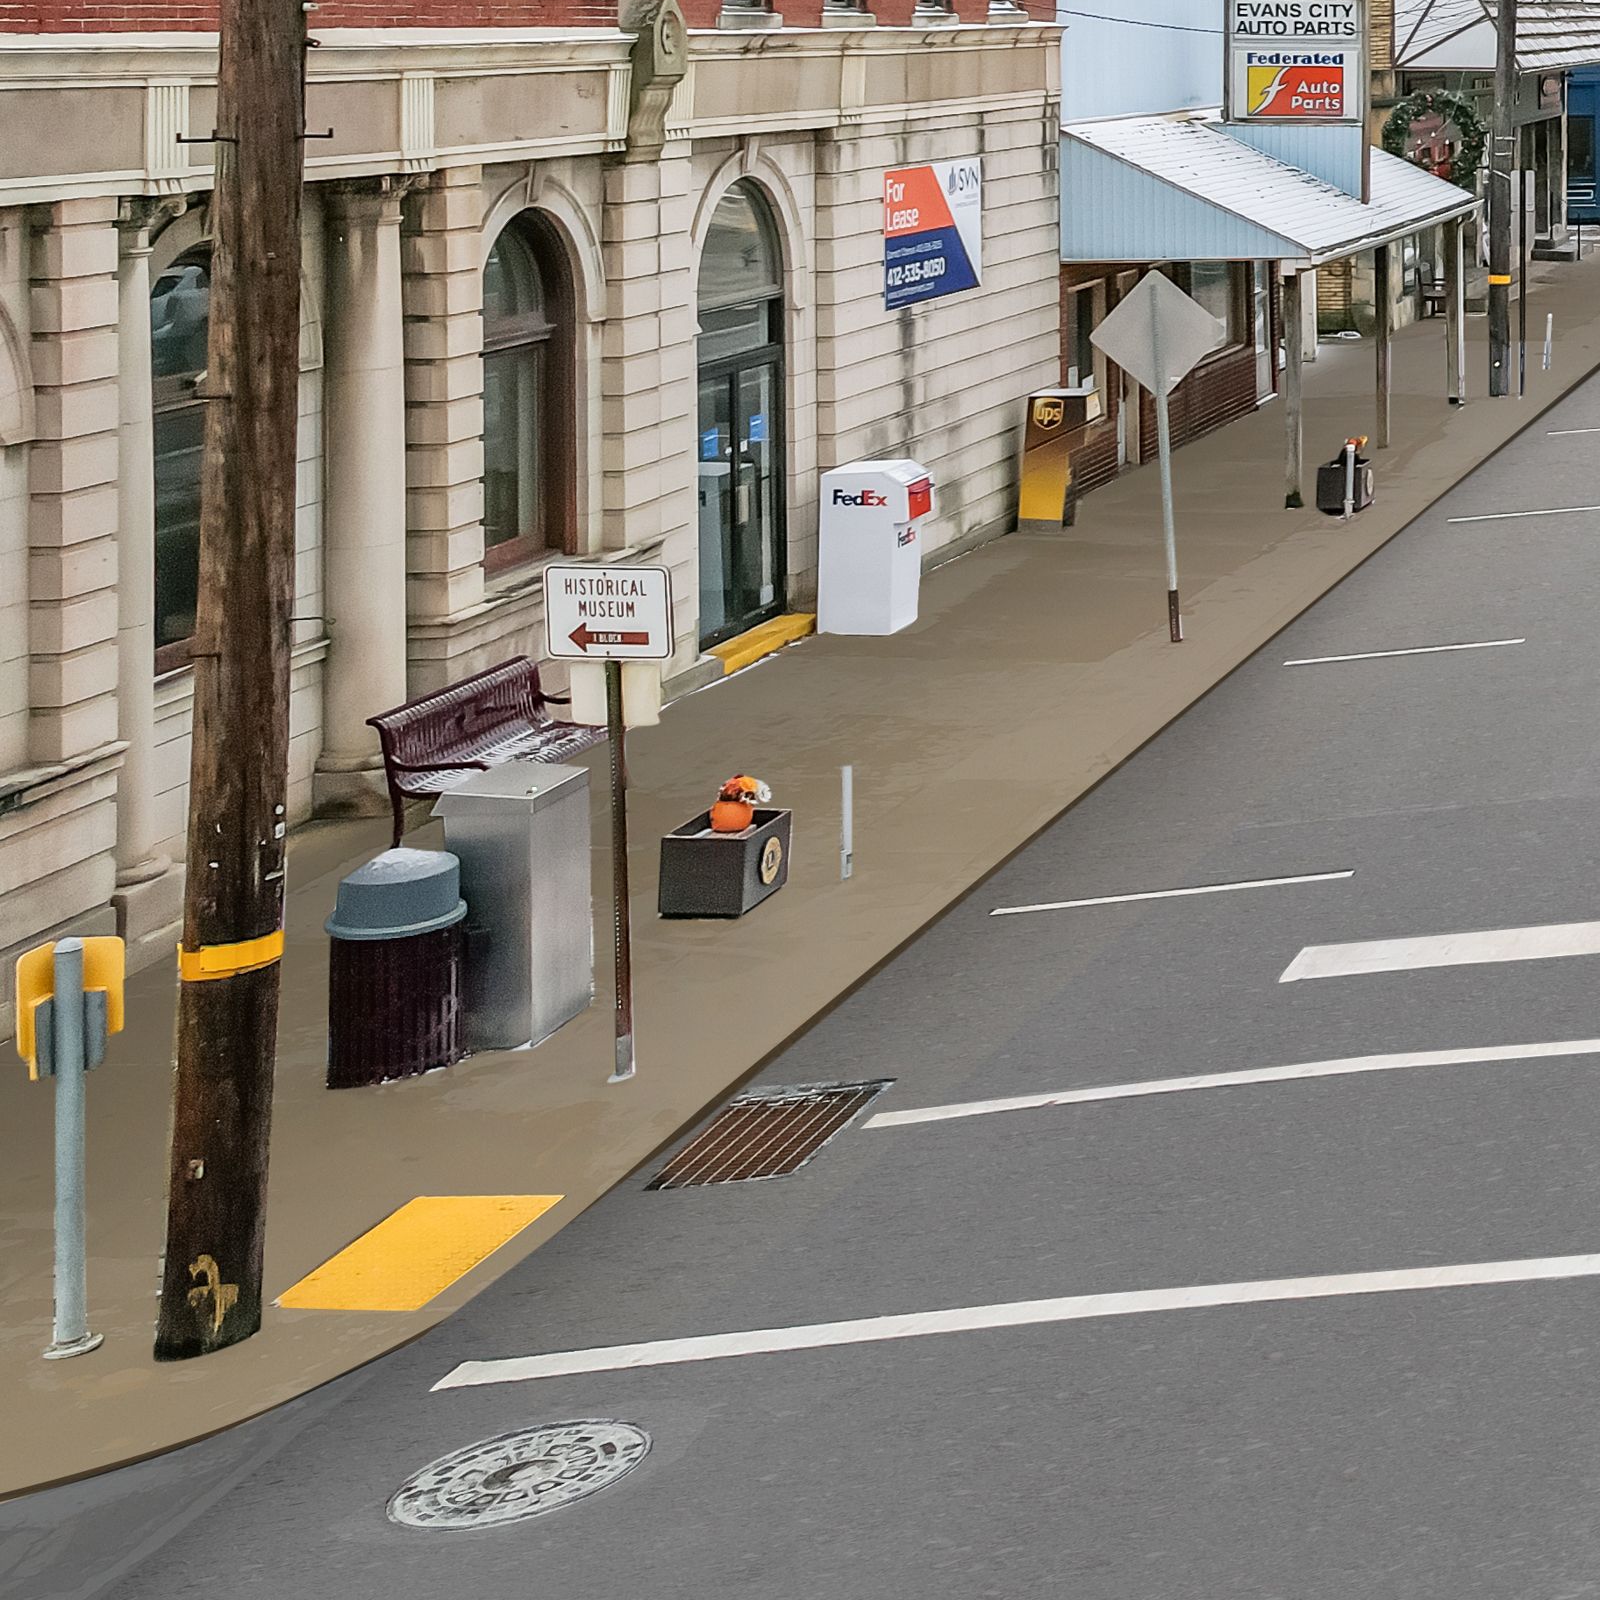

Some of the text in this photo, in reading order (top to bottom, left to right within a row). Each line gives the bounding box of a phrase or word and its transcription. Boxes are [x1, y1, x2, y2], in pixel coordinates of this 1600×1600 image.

[1237, 3, 1354, 18] EVANS CITY
[1236, 20, 1355, 36] AUTO PARTS
[1246, 52, 1345, 66] Federated
[1296, 80, 1341, 95] Auto
[1291, 96, 1341, 110] Parts
[958, 165, 980, 192] SVN
[885, 179, 906, 203] For
[886, 207, 920, 232] Lease
[1035, 407, 1061, 426] ups
[833, 489, 888, 506] FedEx
[564, 578, 647, 597] HISTORICAL
[578, 600, 635, 618] MUSEUM
